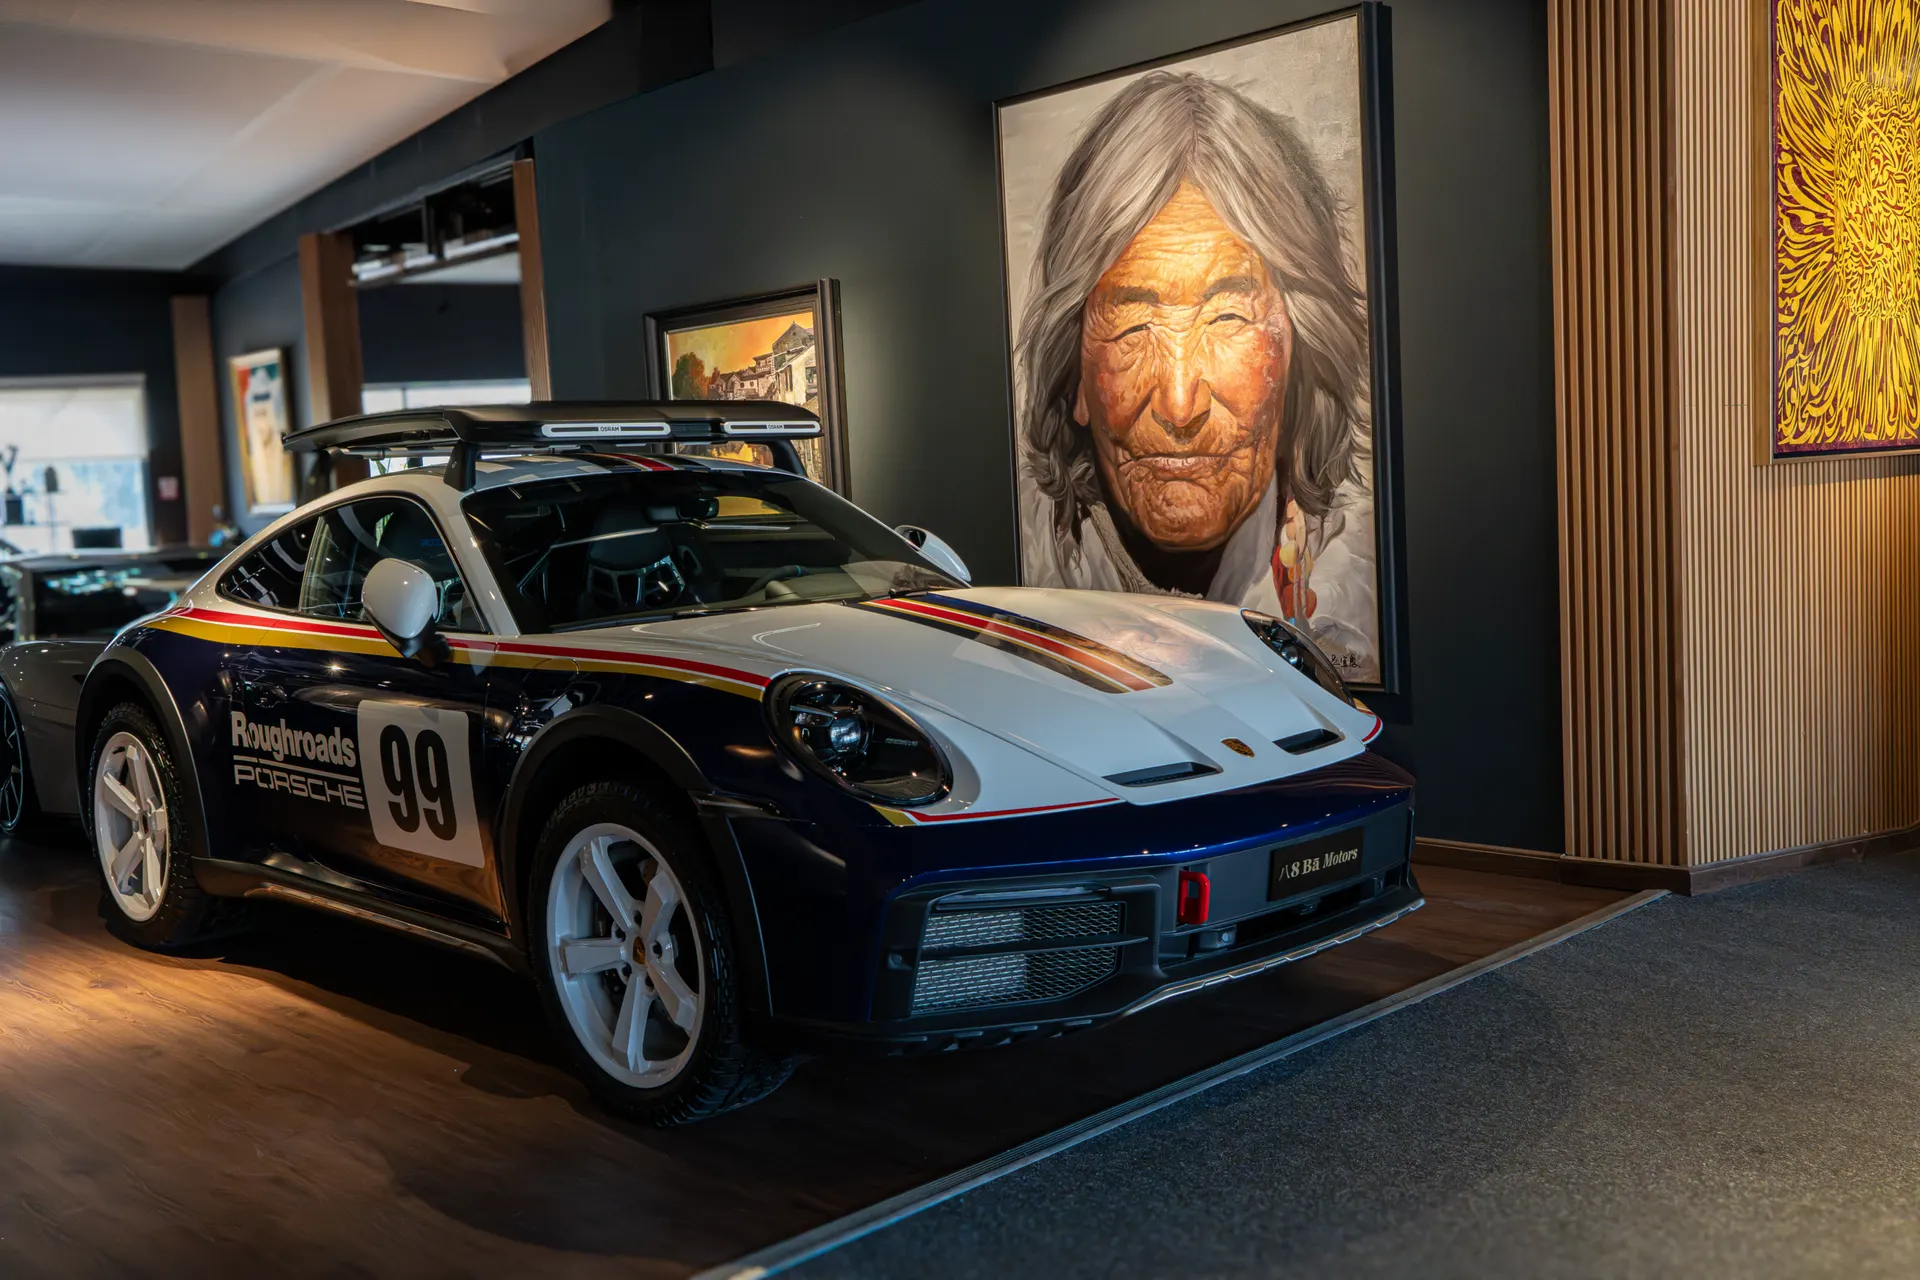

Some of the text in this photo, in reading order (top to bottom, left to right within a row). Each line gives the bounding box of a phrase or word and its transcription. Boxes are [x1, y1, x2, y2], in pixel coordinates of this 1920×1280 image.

[231, 710, 357, 768] Roughroads
[233, 764, 366, 810] PORSCHE
[379, 724, 458, 841] 99
[1322, 848, 1359, 869] Motors
